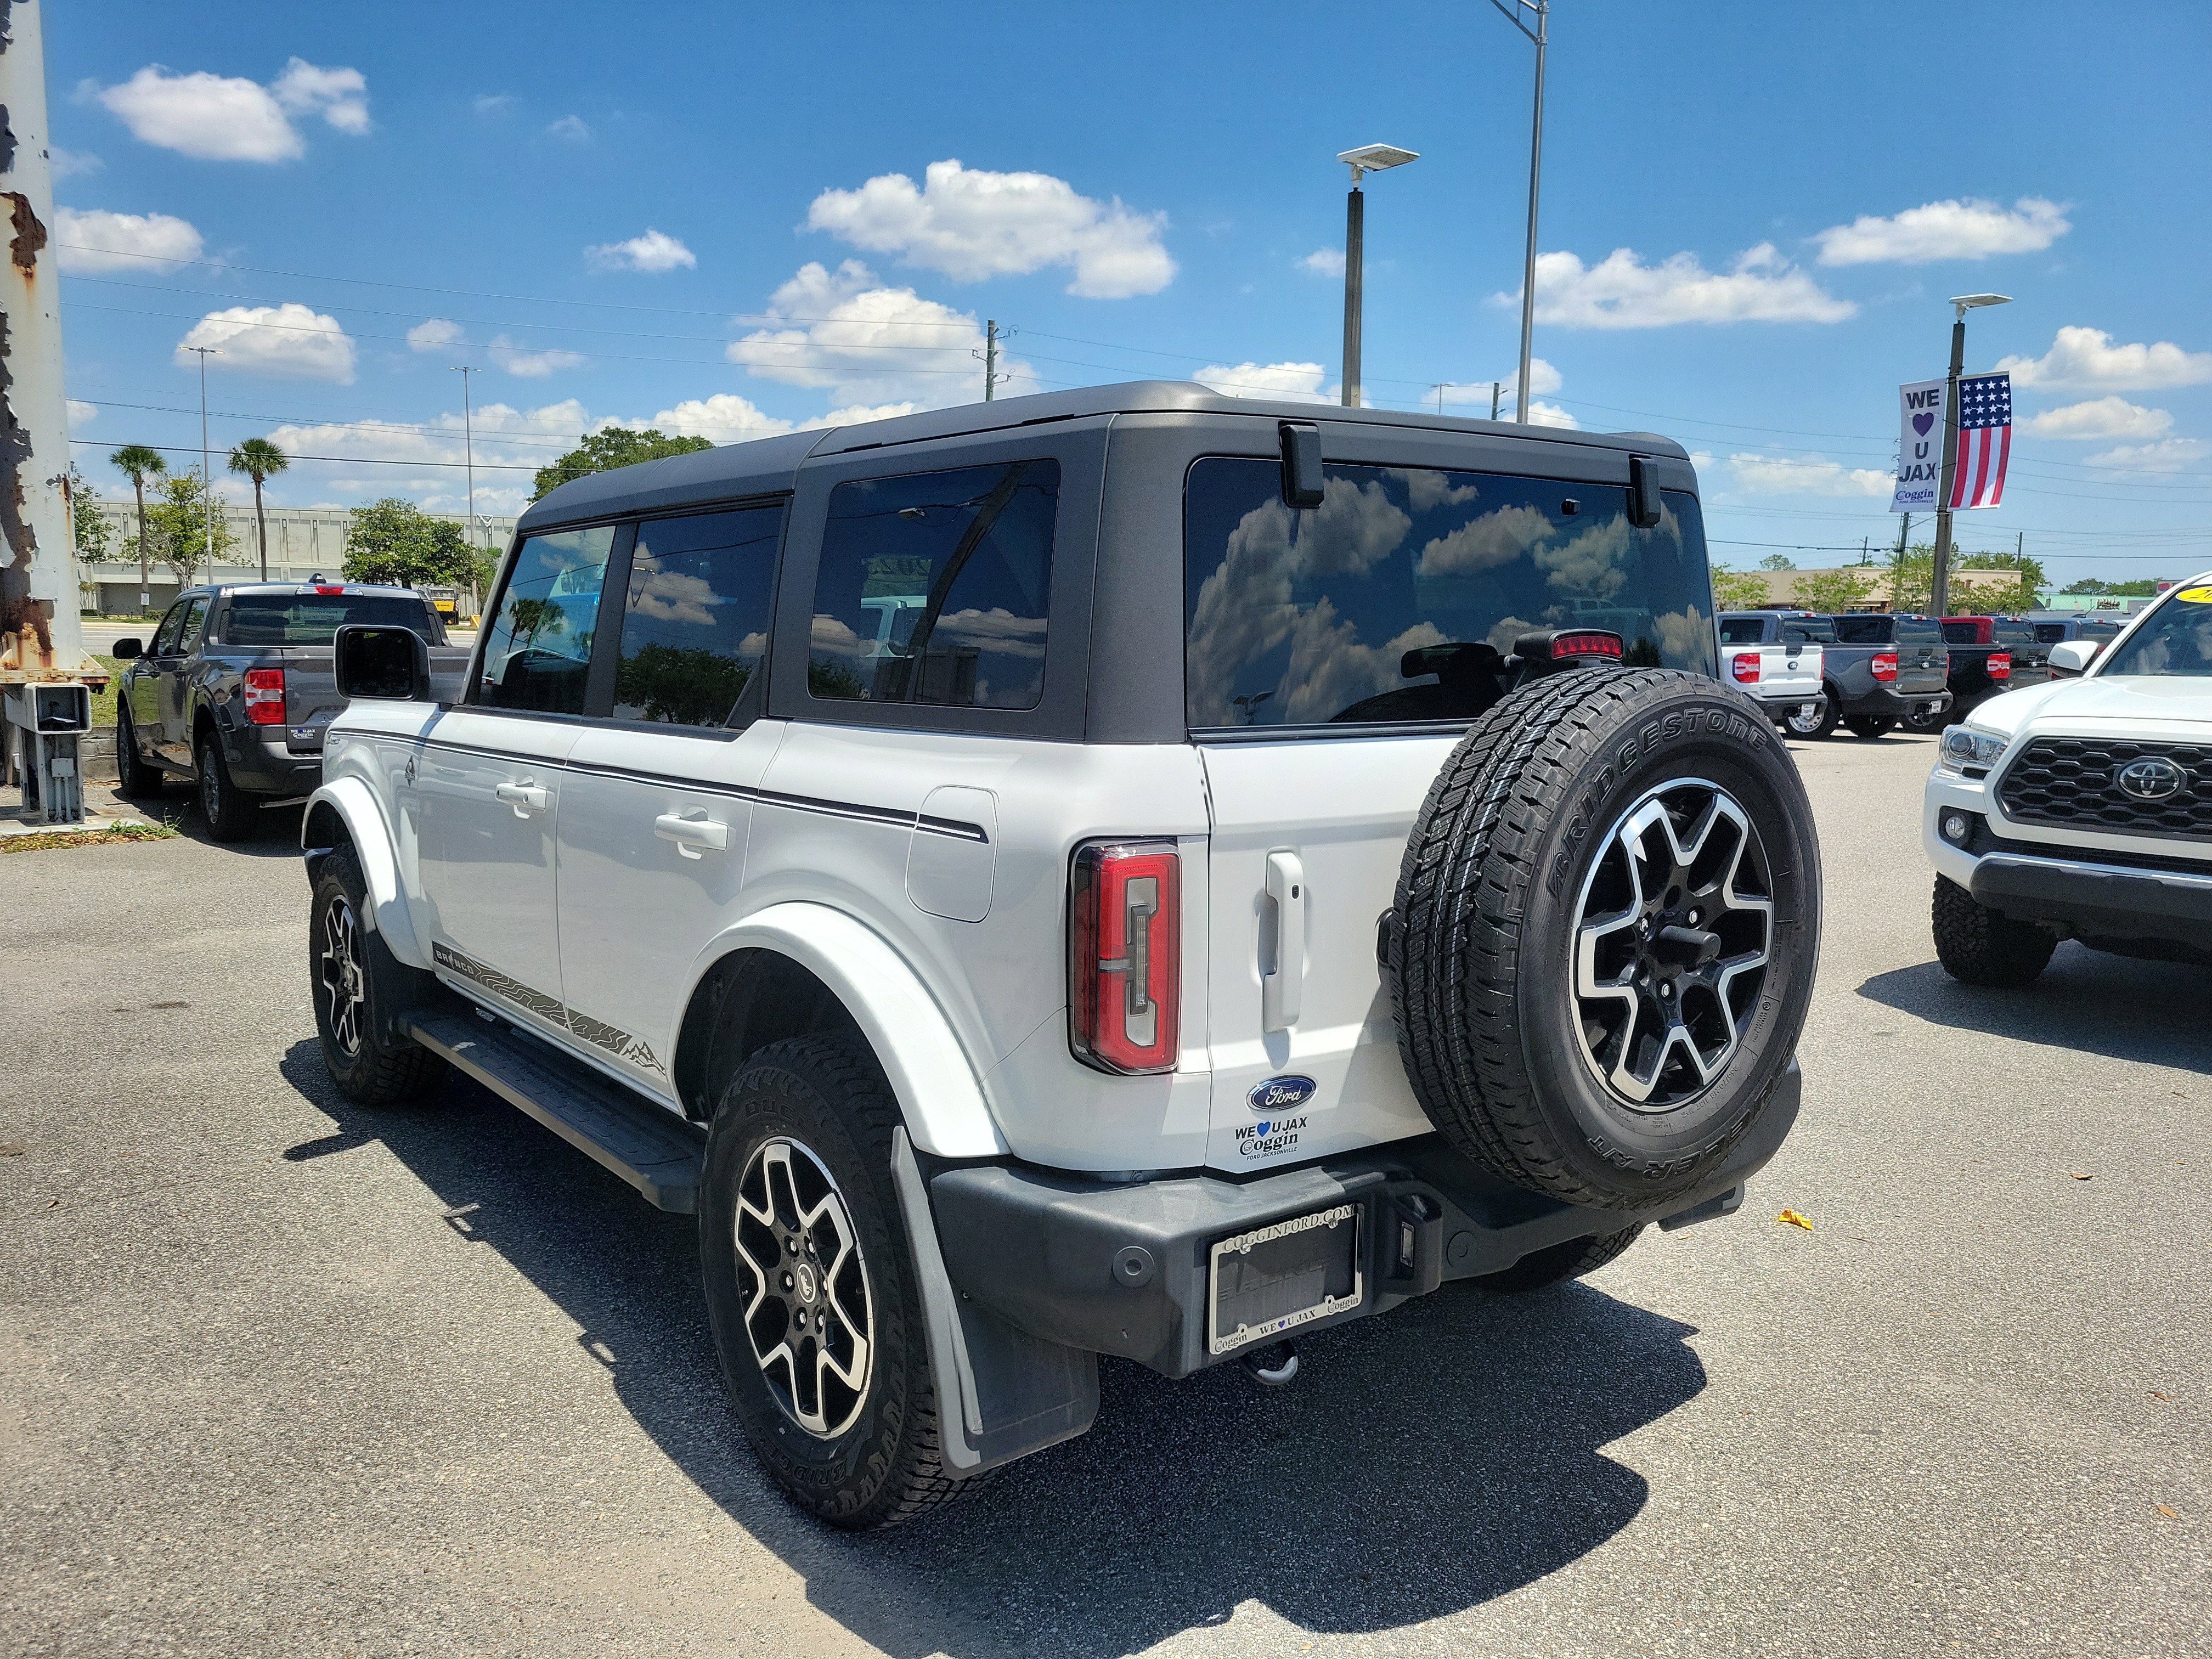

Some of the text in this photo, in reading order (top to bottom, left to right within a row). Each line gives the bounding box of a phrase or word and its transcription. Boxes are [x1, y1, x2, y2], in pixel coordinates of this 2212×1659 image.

[1906, 388, 1939, 409] WE
[1915, 442, 1929, 459] U
[1898, 462, 1937, 482] JAX
[1896, 488, 1934, 500] Coggin
[1545, 708, 1767, 905] BRIDGESTONE
[1265, 1083, 1302, 1106] Ford
[1235, 1116, 1308, 1140] WE U JAX
[1239, 1131, 1299, 1155] Coggin
[1261, 1146, 1297, 1159] JACKSONVILLE
[1223, 1205, 1355, 1251] COGGINFORD.COM
[1328, 1296, 1359, 1313] Coggin
[1260, 1309, 1316, 1335] WE U JAX
[1215, 1333, 1248, 1352] Coggin
